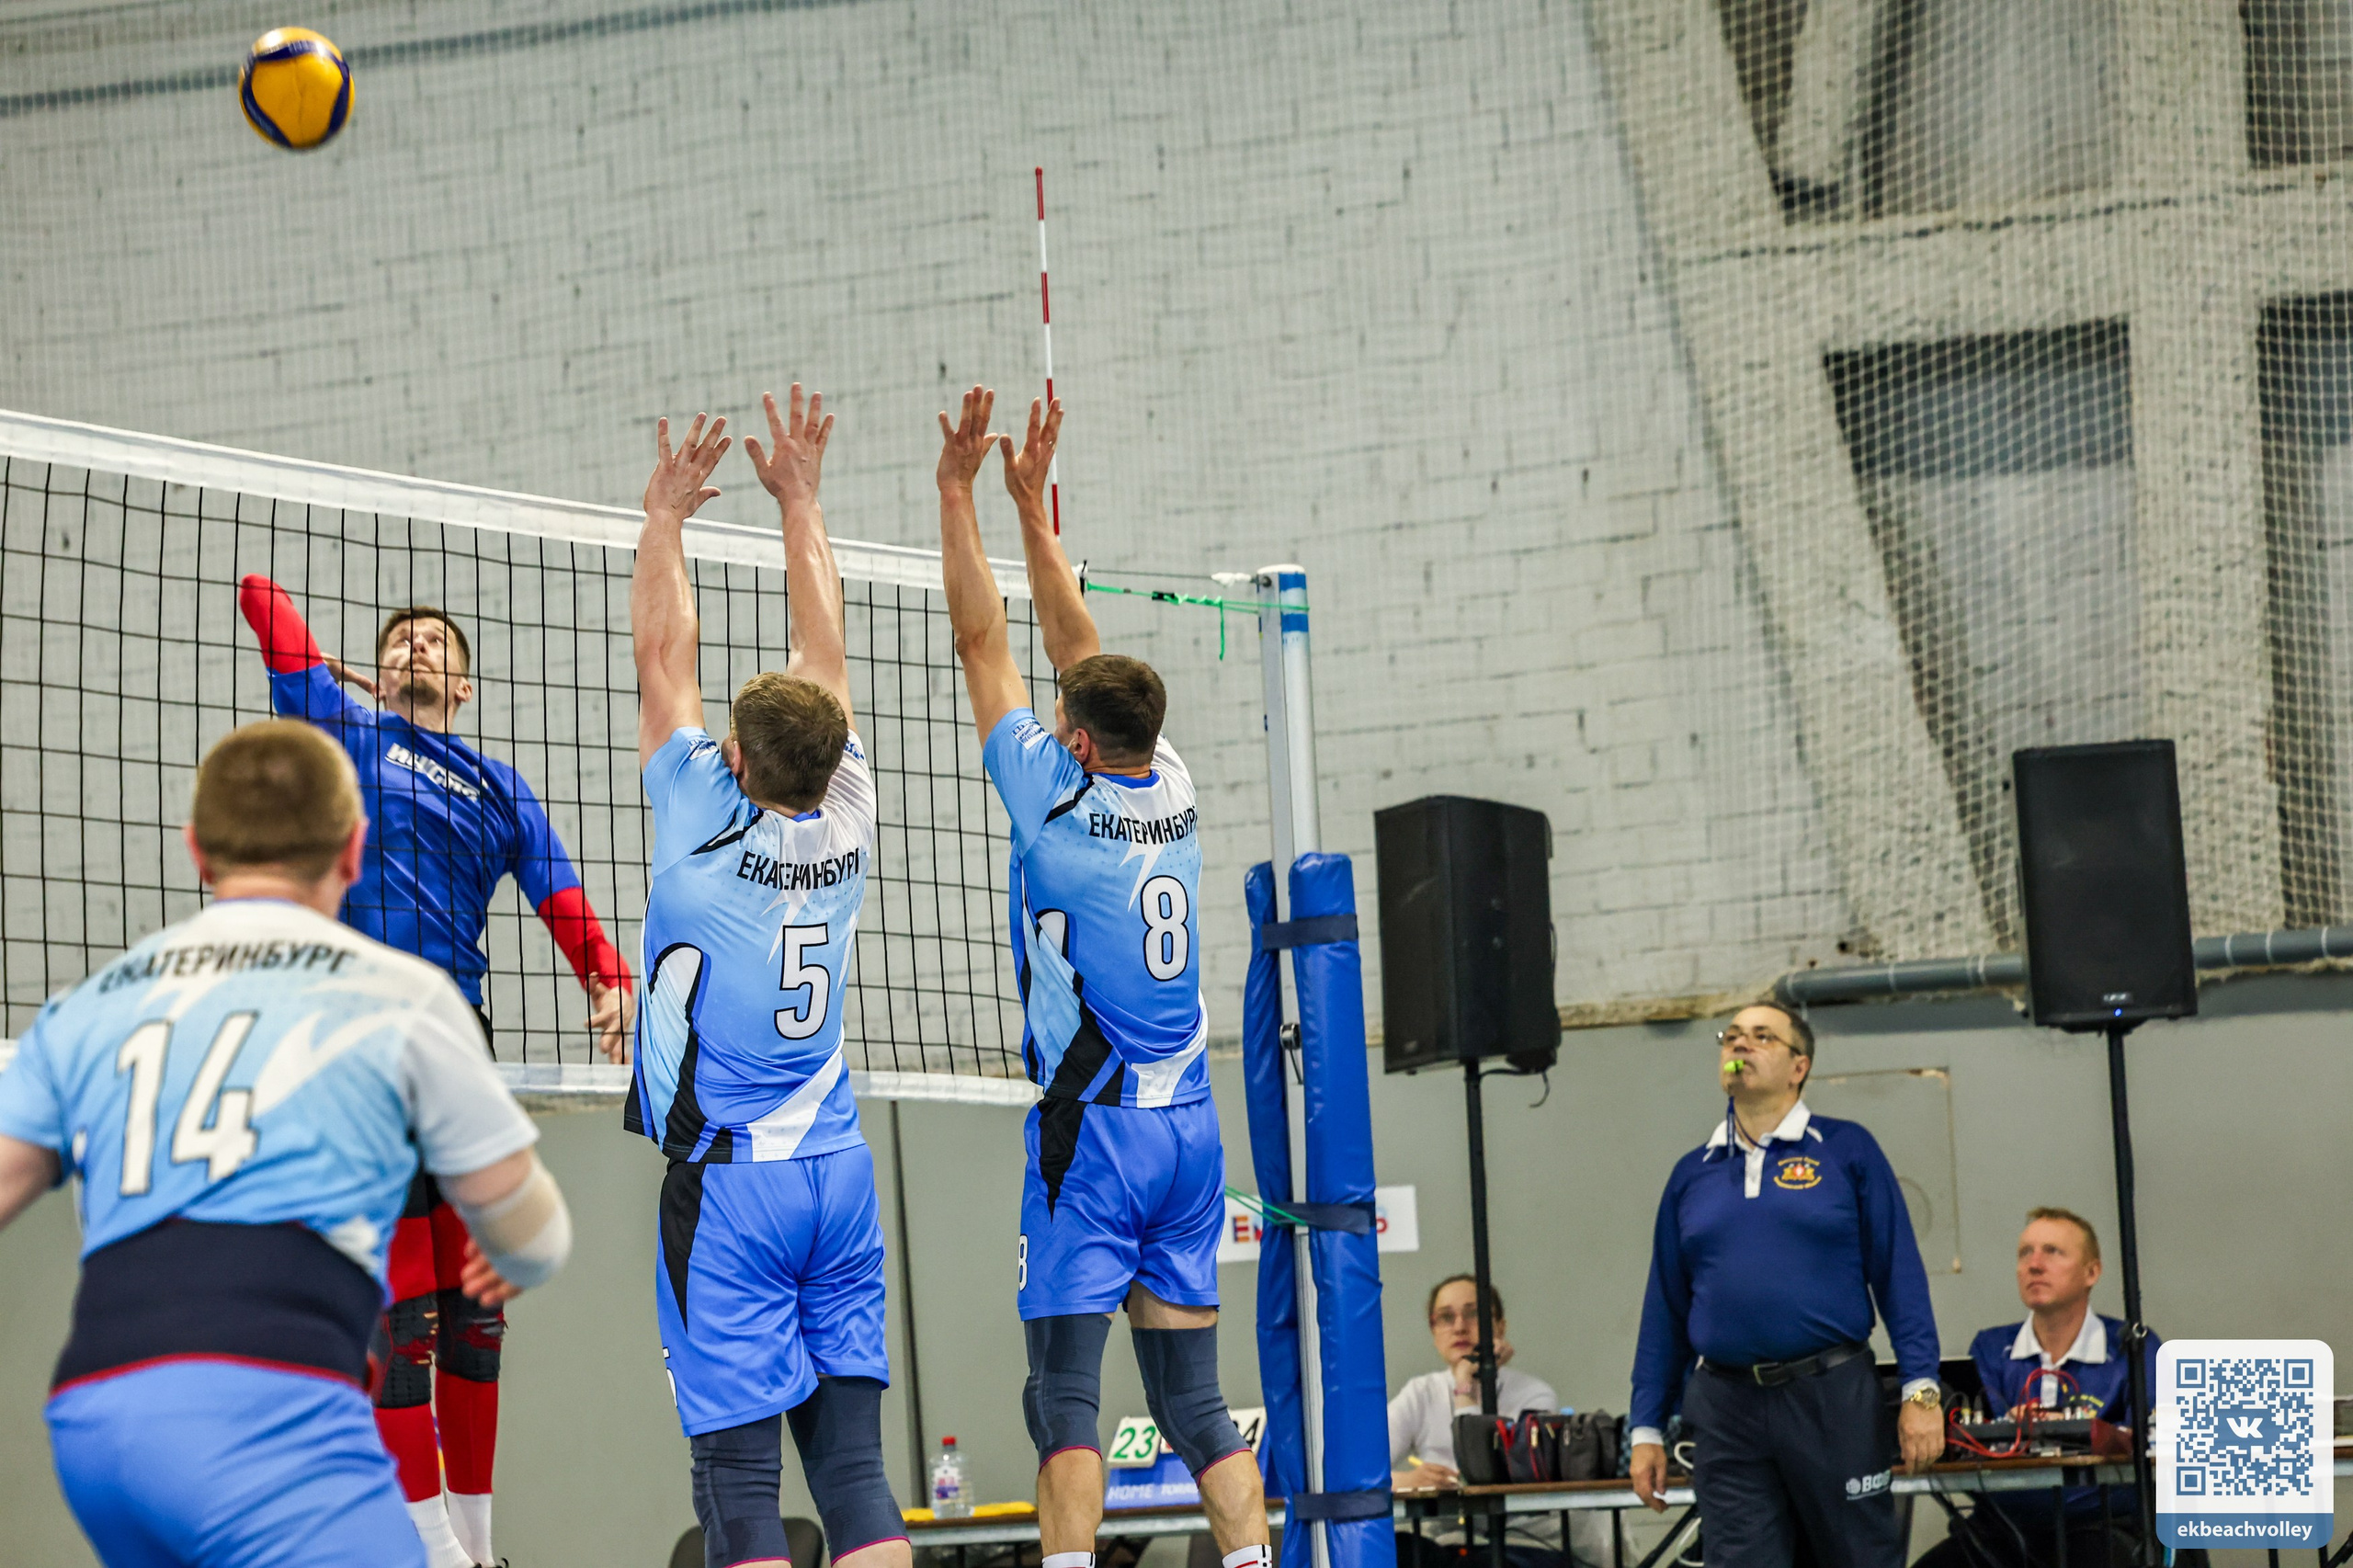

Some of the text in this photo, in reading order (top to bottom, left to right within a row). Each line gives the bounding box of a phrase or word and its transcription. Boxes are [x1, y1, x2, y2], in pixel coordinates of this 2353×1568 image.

[1089, 805, 1198, 845] ЕКАТЕРИНБУР
[1142, 876, 1190, 982] 8
[774, 923, 831, 1041] 5
[117, 1010, 261, 1196] 14
[1113, 1426, 1156, 1459] 23
[1233, 1417, 1260, 1449] 4
